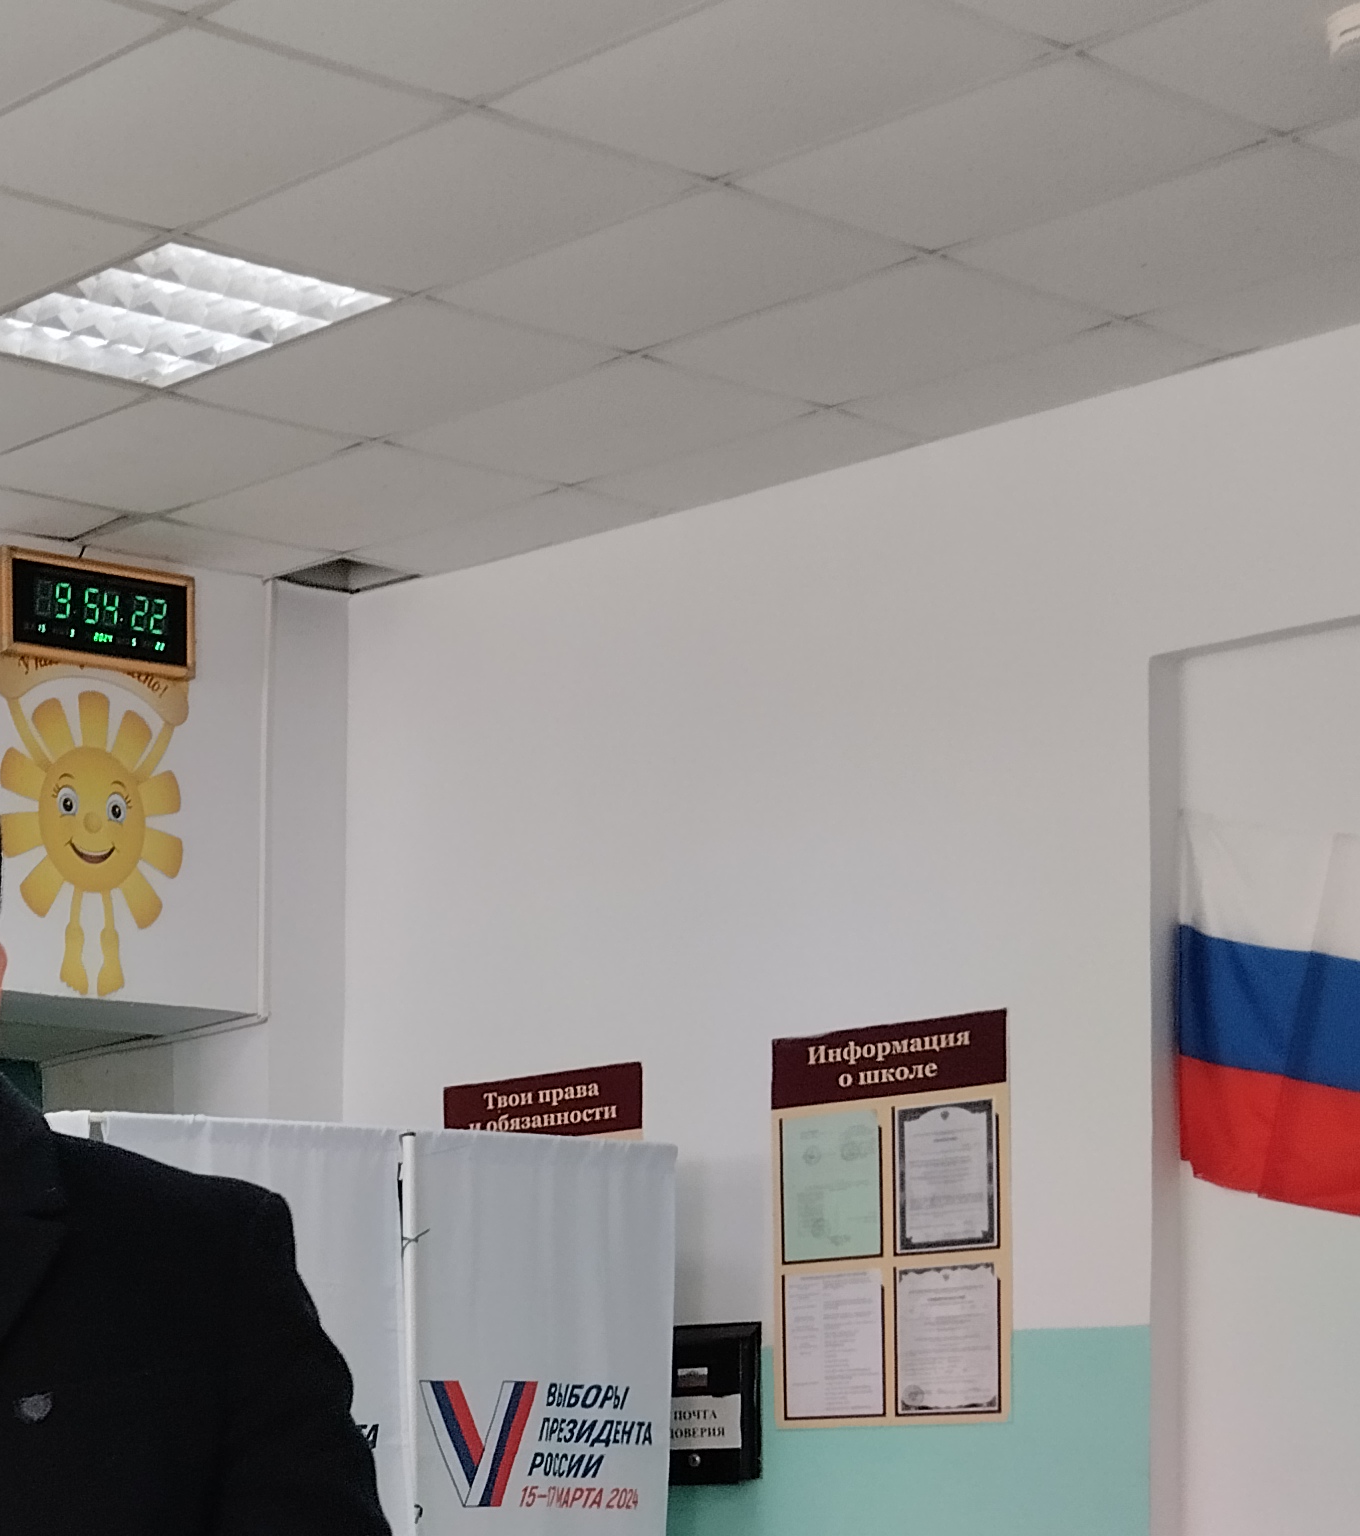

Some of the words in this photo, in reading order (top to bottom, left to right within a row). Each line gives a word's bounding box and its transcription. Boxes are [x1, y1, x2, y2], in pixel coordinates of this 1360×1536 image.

[807, 1030, 971, 1065] Информация
[838, 1072, 853, 1088] о
[858, 1061, 938, 1086] школе
[483, 1091, 533, 1110] Твои
[538, 1082, 599, 1107] права
[486, 1104, 617, 1132] обязанности
[545, 1382, 630, 1410] ВЫБОРЫ
[673, 1410, 717, 1421] ПОЧТА
[538, 1417, 653, 1447] ПРЕЗИДЕНТА
[527, 1452, 606, 1478] РОССИИ
